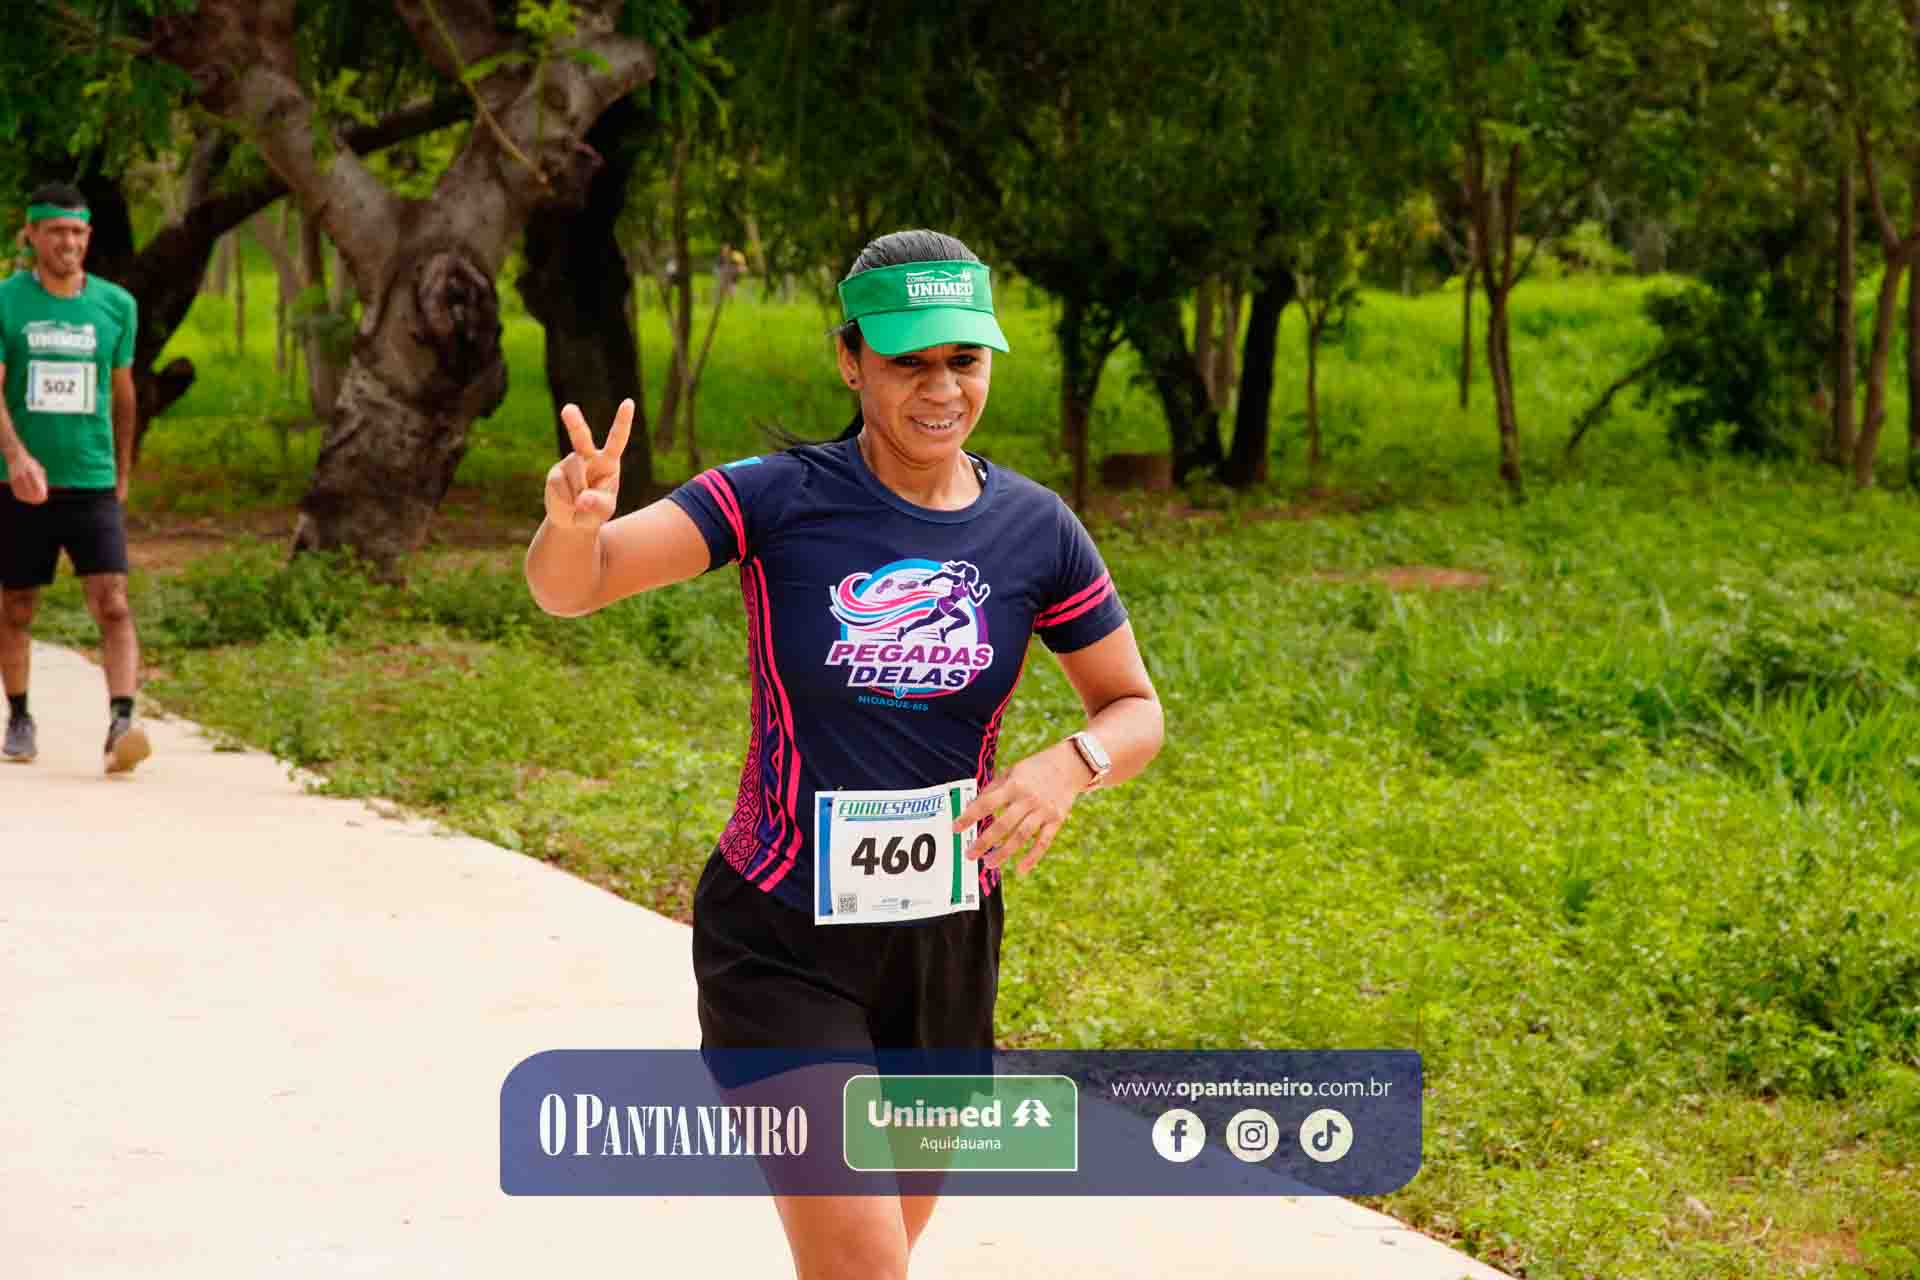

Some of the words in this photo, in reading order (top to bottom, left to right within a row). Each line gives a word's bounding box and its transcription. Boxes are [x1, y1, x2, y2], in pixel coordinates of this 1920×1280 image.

[906, 282, 974, 297] UNIMED
[43, 379, 76, 393] 502
[829, 643, 993, 668] PEGADAS
[851, 666, 970, 688] DELAS
[851, 833, 937, 876] 460
